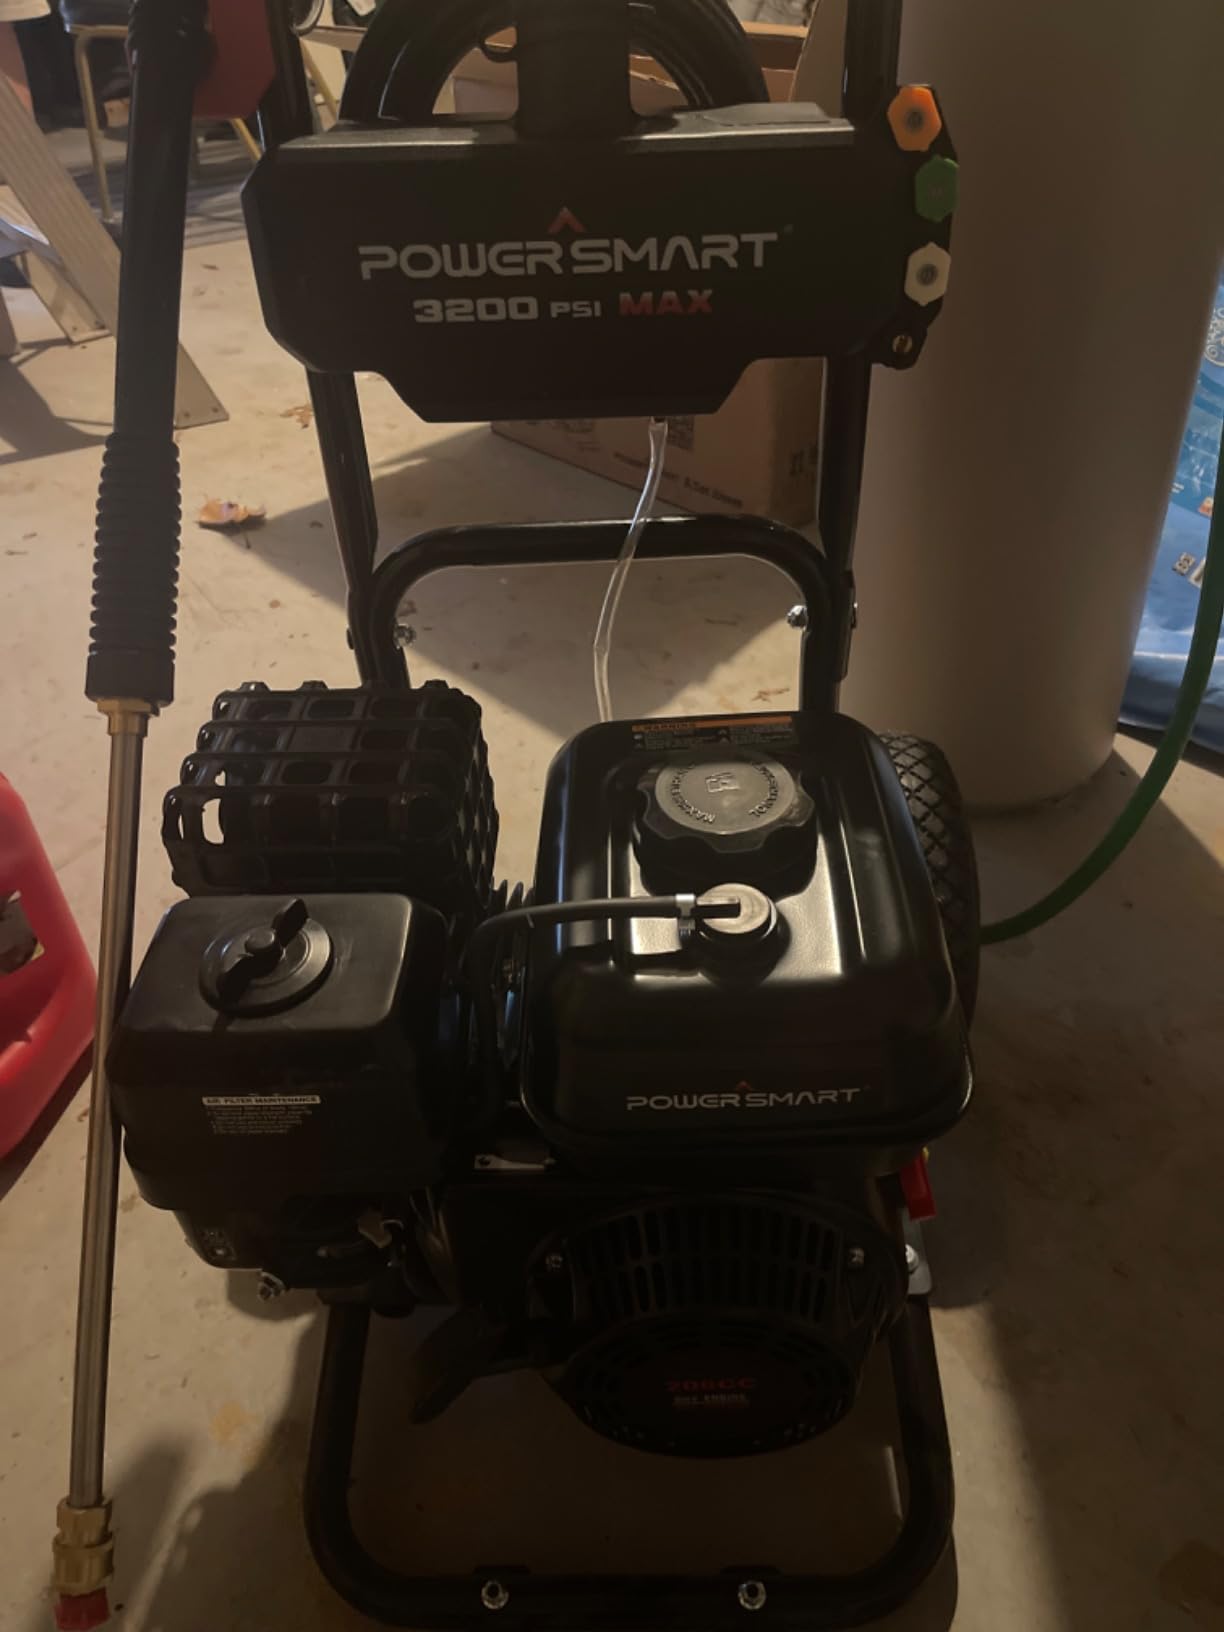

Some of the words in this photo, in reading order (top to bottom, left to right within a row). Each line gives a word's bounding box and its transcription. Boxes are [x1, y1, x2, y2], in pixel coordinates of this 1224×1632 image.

[412, 295, 539, 324] 3200
[549, 300, 602, 321] PSI
[618, 288, 714, 317] MAX
